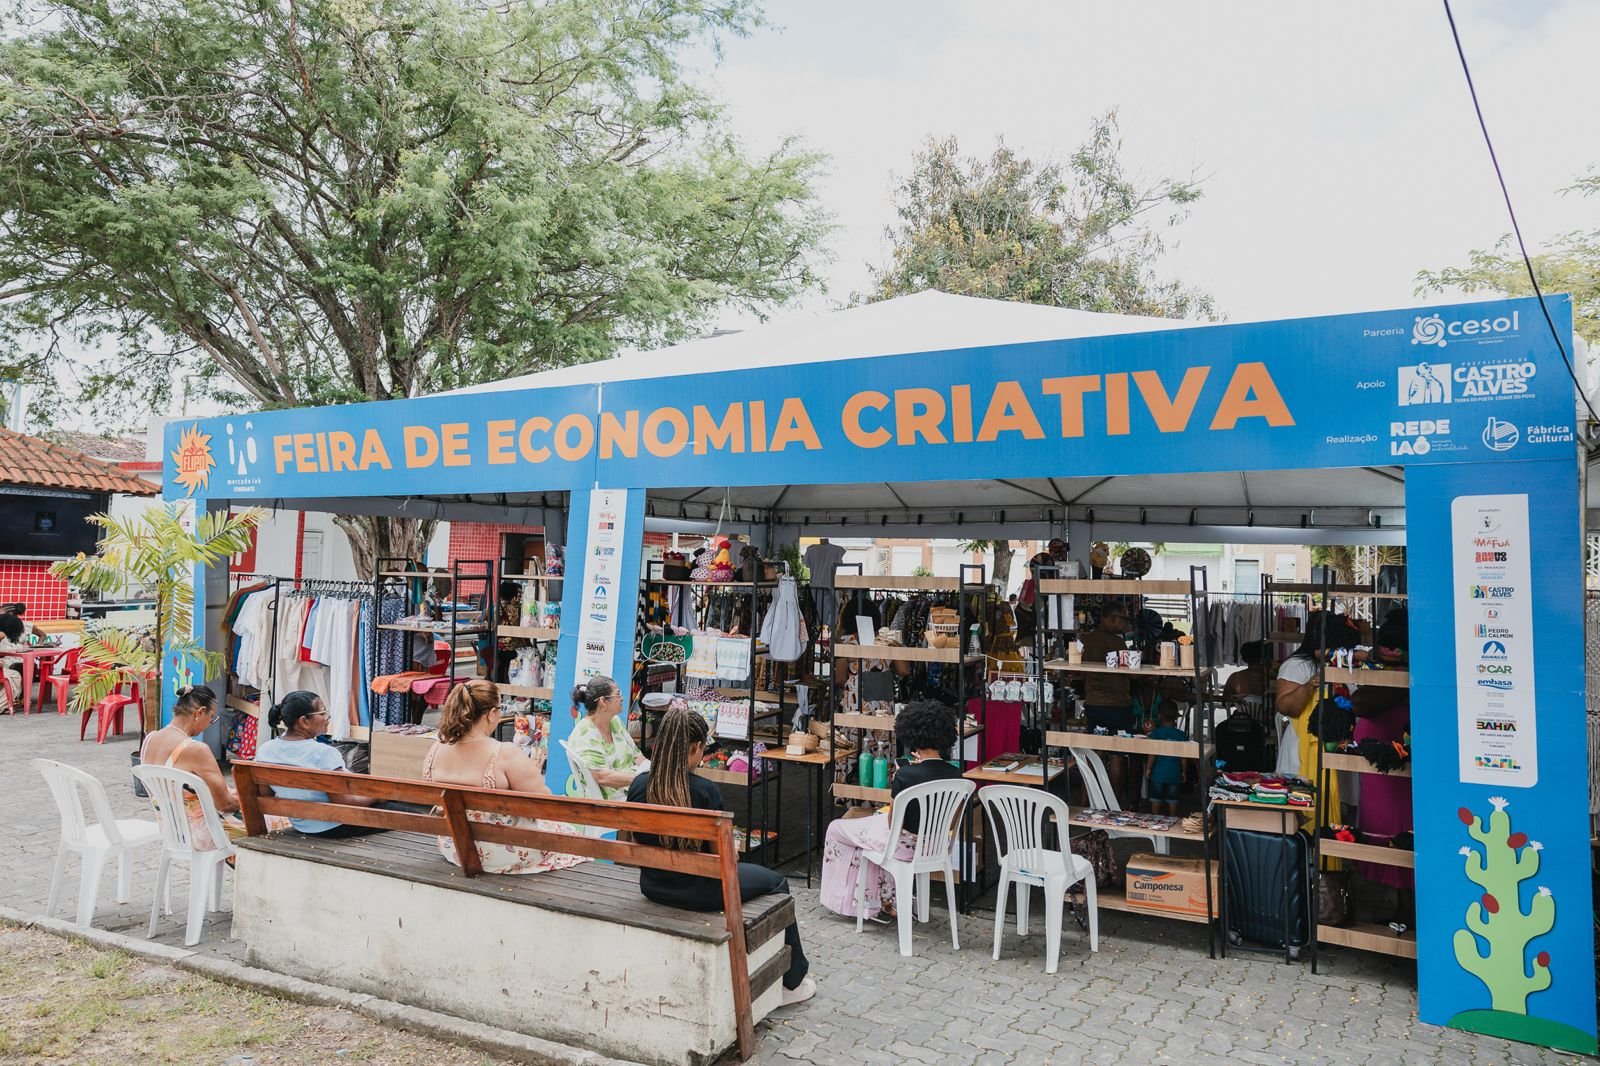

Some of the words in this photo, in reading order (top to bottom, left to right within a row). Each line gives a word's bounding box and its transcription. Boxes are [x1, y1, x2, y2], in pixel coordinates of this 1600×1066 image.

[1447, 311, 1519, 336] cesol
[1363, 326, 1404, 337] Parceria
[1453, 362, 1536, 383] CASTRO
[1356, 380, 1386, 390] Apoio
[1462, 378, 1528, 397] ALVES
[272, 428, 393, 474] FEIRA
[403, 422, 471, 469] DE
[486, 397, 823, 465] ECONOMIA
[841, 361, 1297, 449] CRIATIVA
[1390, 419, 1450, 437] REDE
[1527, 424, 1569, 434] Fábrica
[1326, 433, 1378, 446] Realização
[1527, 432, 1574, 444] Cultural
[586, 643, 605, 652] BAHIA
[1486, 664, 1513, 674] CAR
[1477, 678, 1513, 686] embasa
[1476, 721, 1517, 732] BAHIA
[1133, 880, 1184, 893] Camponesa
